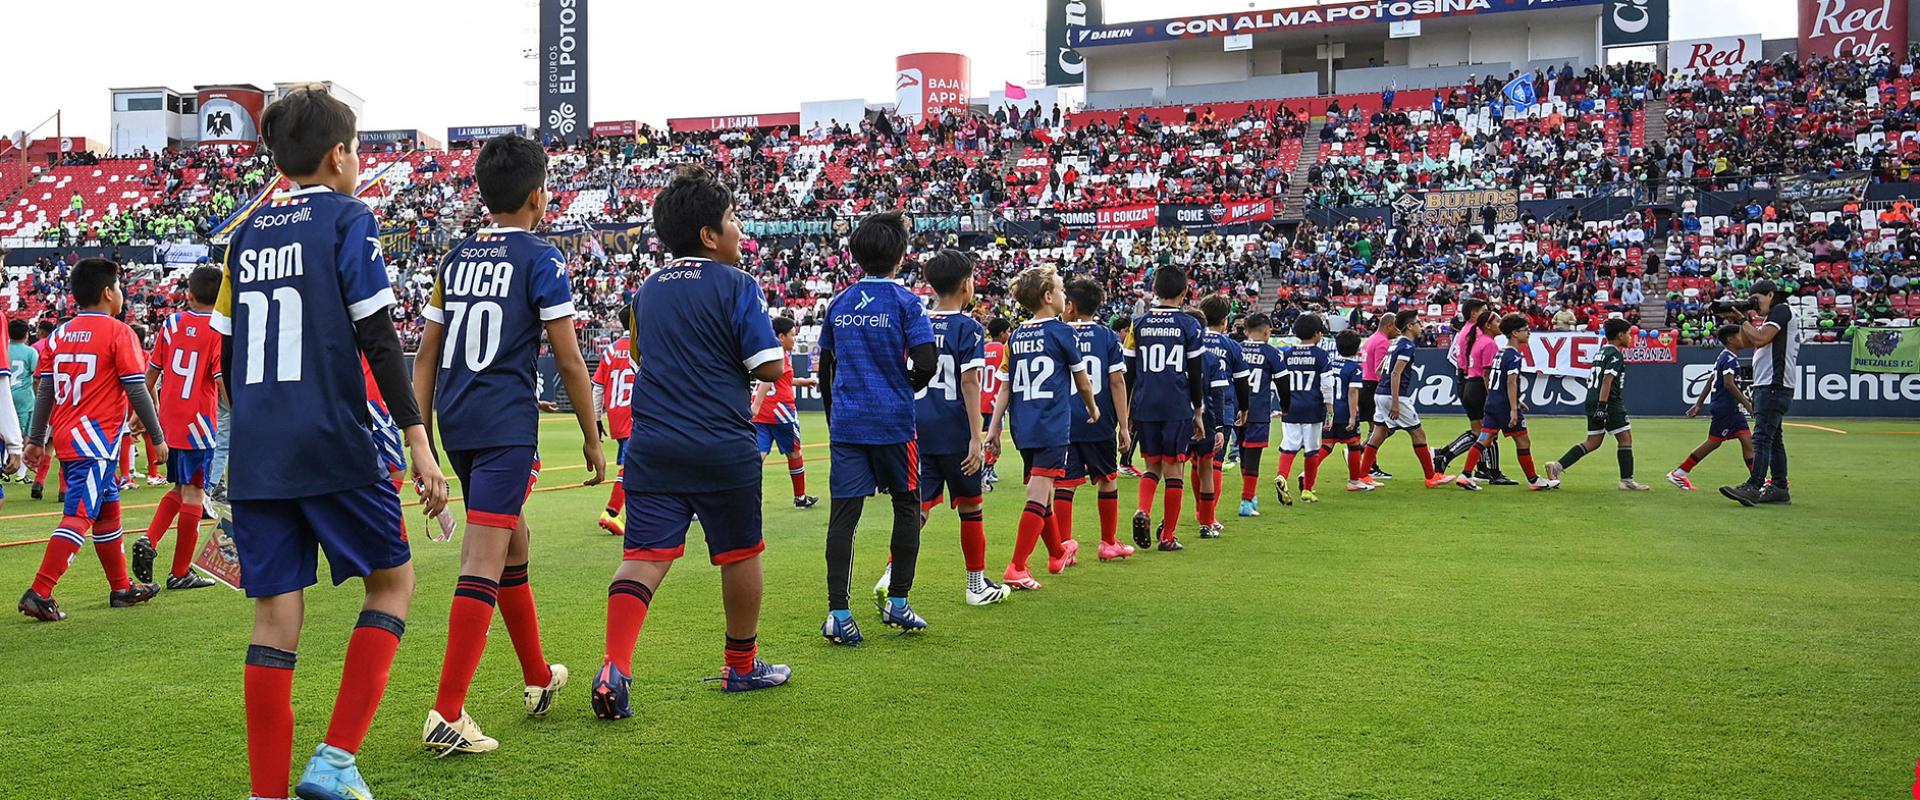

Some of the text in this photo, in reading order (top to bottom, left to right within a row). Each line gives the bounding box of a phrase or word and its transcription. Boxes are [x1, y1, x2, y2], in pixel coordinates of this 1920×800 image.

[1165, 0, 1491, 36] CON ALMA POTOSINA
[1808, 0, 1894, 39] Red
[1090, 28, 1134, 40] DAIKIN
[1685, 38, 1748, 69] Red
[549, 45, 558, 94] SEGUROS
[560, 69, 576, 94] EL
[928, 78, 960, 90] BAJA
[928, 92, 957, 104] APP
[1424, 189, 1519, 210] BUHOS
[1098, 211, 1111, 223] LA
[1177, 209, 1204, 221] COKE
[1471, 204, 1518, 225] LIS
[239, 242, 304, 284] SAM
[444, 261, 514, 298] LUCA
[63, 331, 93, 343] MATEO
[238, 286, 303, 384] 11
[442, 301, 503, 372] 70
[1140, 327, 1181, 337] NAVARRO
[1633, 334, 1648, 348] LA
[1012, 339, 1044, 355] NIELS
[1139, 344, 1184, 373] 104
[53, 353, 97, 406] 67
[171, 348, 199, 400] 4
[609, 368, 636, 409] 16
[1012, 355, 1055, 401] 42
[1287, 370, 1316, 391] 117
[425, 720, 473, 749] NIKE
